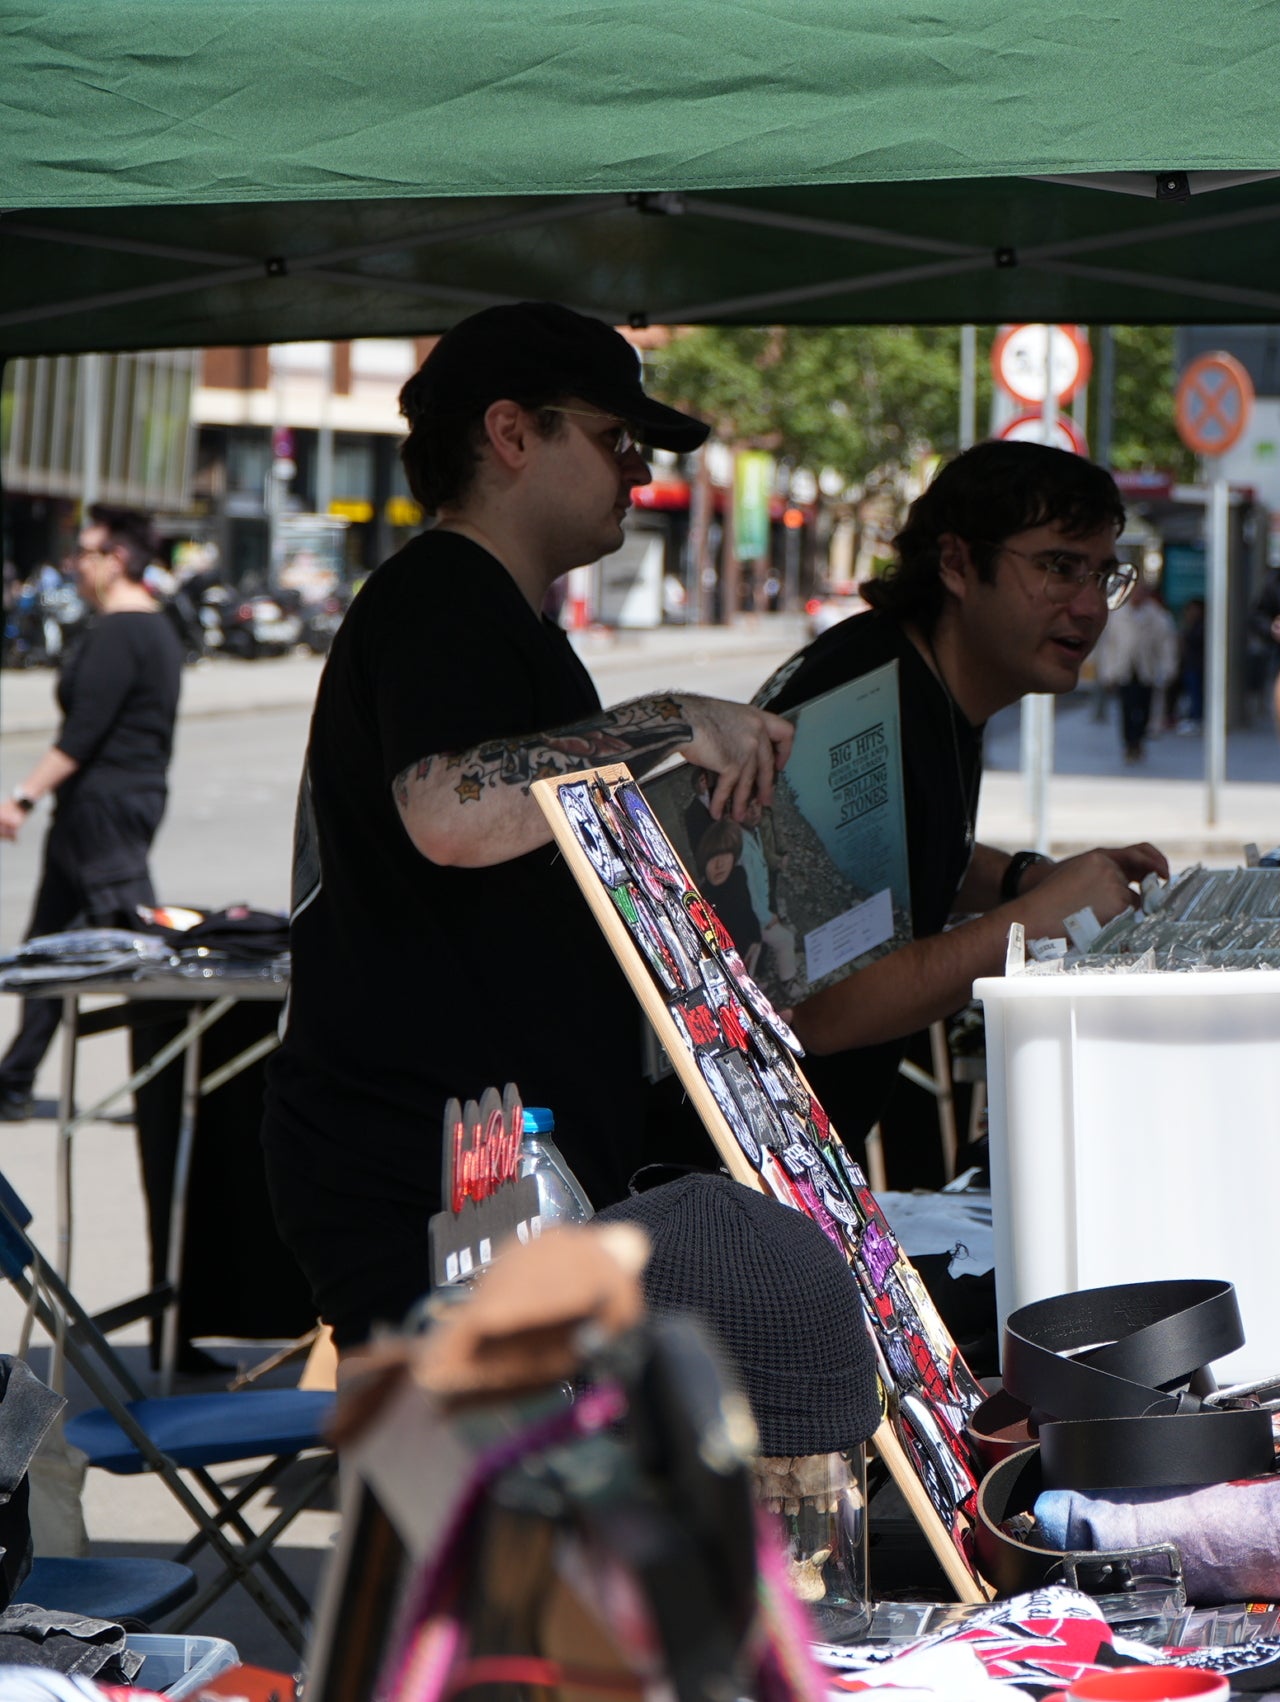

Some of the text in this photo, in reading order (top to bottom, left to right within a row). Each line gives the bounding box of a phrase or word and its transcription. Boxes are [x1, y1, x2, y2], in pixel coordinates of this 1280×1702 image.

[830, 726, 884, 769] BIG HITS
[841, 784, 888, 821] STONES
[844, 767, 888, 802] ROLLING
